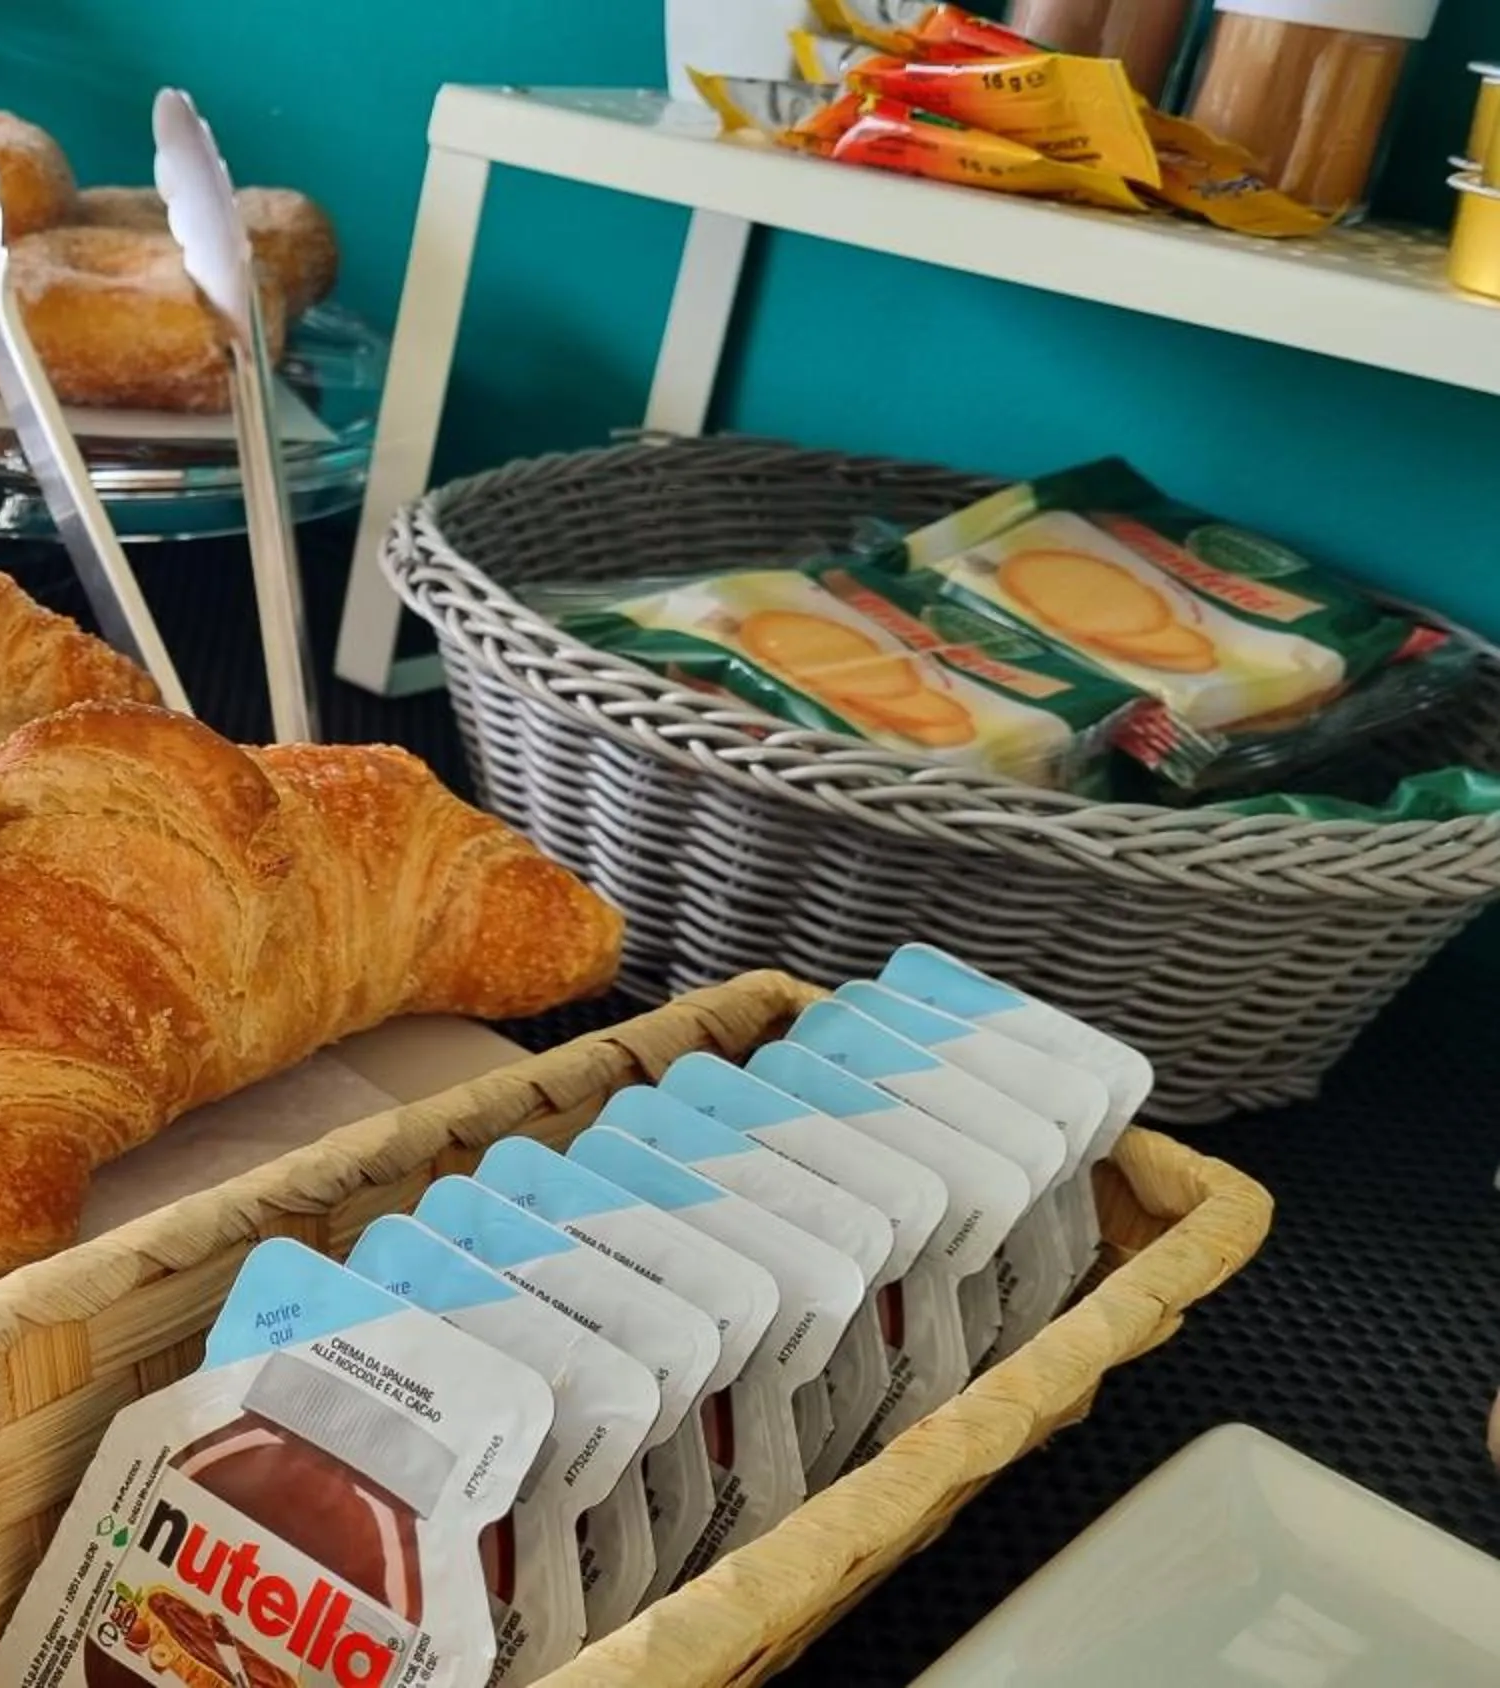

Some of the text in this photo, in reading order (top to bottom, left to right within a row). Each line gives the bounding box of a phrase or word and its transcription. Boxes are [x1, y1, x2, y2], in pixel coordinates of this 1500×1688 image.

[255, 1302, 301, 1329] Aprire
[269, 1328, 294, 1347] qui
[310, 1343, 336, 1363] ALLE
[336, 1357, 384, 1391] NOCCIOLE
[391, 1388, 404, 1402] AL
[404, 1396, 442, 1424] CACAO
[331, 1337, 435, 1401] CREMA DA SPALMARE
[139, 1499, 394, 1688] nutella
